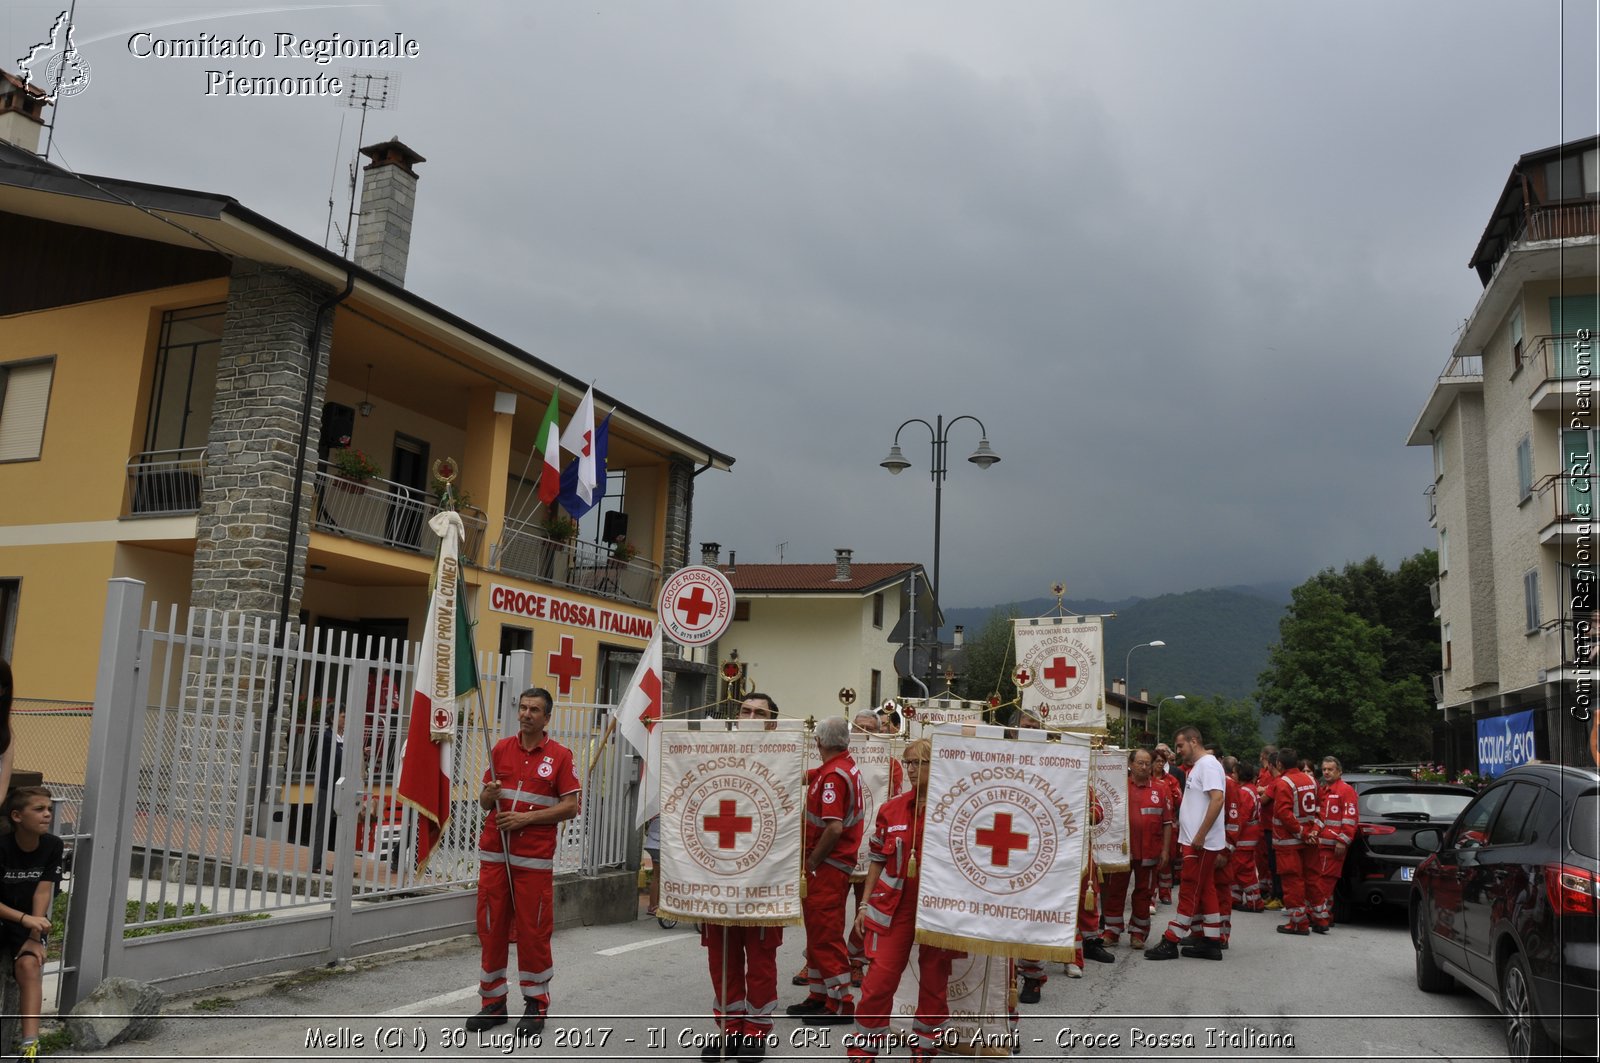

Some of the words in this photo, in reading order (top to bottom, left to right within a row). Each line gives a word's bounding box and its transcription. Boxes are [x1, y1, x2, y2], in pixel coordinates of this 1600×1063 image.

[441, 556, 457, 597] CUNEO
[663, 579, 683, 609] CROCE
[683, 573, 711, 583] ROSSA
[711, 580, 727, 618] ITALIANA
[492, 587, 546, 618] CROCE
[549, 599, 596, 628] ROSSA
[600, 610, 653, 639] ITALIANA
[670, 622, 680, 634] TEL.
[1022, 644, 1041, 669] CROCE
[1041, 636, 1068, 647] ROSSA
[1071, 639, 1097, 666] ITALIANA
[435, 643, 450, 698] COMITATO
[1046, 713, 1079, 721] BARGE
[669, 745, 692, 754] CORPO
[696, 744, 736, 754] VOLONTARI
[740, 744, 754, 754] DEL
[759, 743, 797, 753] SOCCORSO
[939, 748, 966, 760] CORPO
[970, 751, 1015, 764] VOLONTARI
[1019, 755, 1035, 766] DEL
[1039, 756, 1081, 769] SOCCORSO
[1479, 736, 1504, 773] acqua
[1513, 731, 1533, 764] eva
[664, 770, 697, 814] CROCE
[697, 757, 746, 776] ROSSA
[749, 761, 795, 816] ITALIANA
[698, 786, 708, 798] DI
[712, 778, 759, 797] GINEVRA
[757, 797, 770, 810] 22
[931, 778, 970, 823] CROCE
[971, 766, 1025, 785] ROSSA
[1028, 774, 1078, 837] ITALIANA
[970, 796, 983, 809] DI
[986, 789, 1038, 813] GINEVRA
[757, 813, 773, 852] AGOSTO
[1036, 813, 1050, 828] 22
[684, 799, 716, 869] CONVENZIONE
[953, 809, 987, 886] CONVENZIONE
[1034, 831, 1054, 872] AGOSTO
[664, 881, 720, 897] GRUPPO
[727, 886, 739, 898] DI
[745, 884, 794, 898] MELLE
[666, 895, 728, 915] COMITATO
[736, 902, 792, 914] LOCALE
[922, 895, 966, 912] GRUPPO
[970, 902, 980, 914] DI
[983, 904, 1071, 924] PONTECHIANALE
[949, 983, 968, 997] 864
